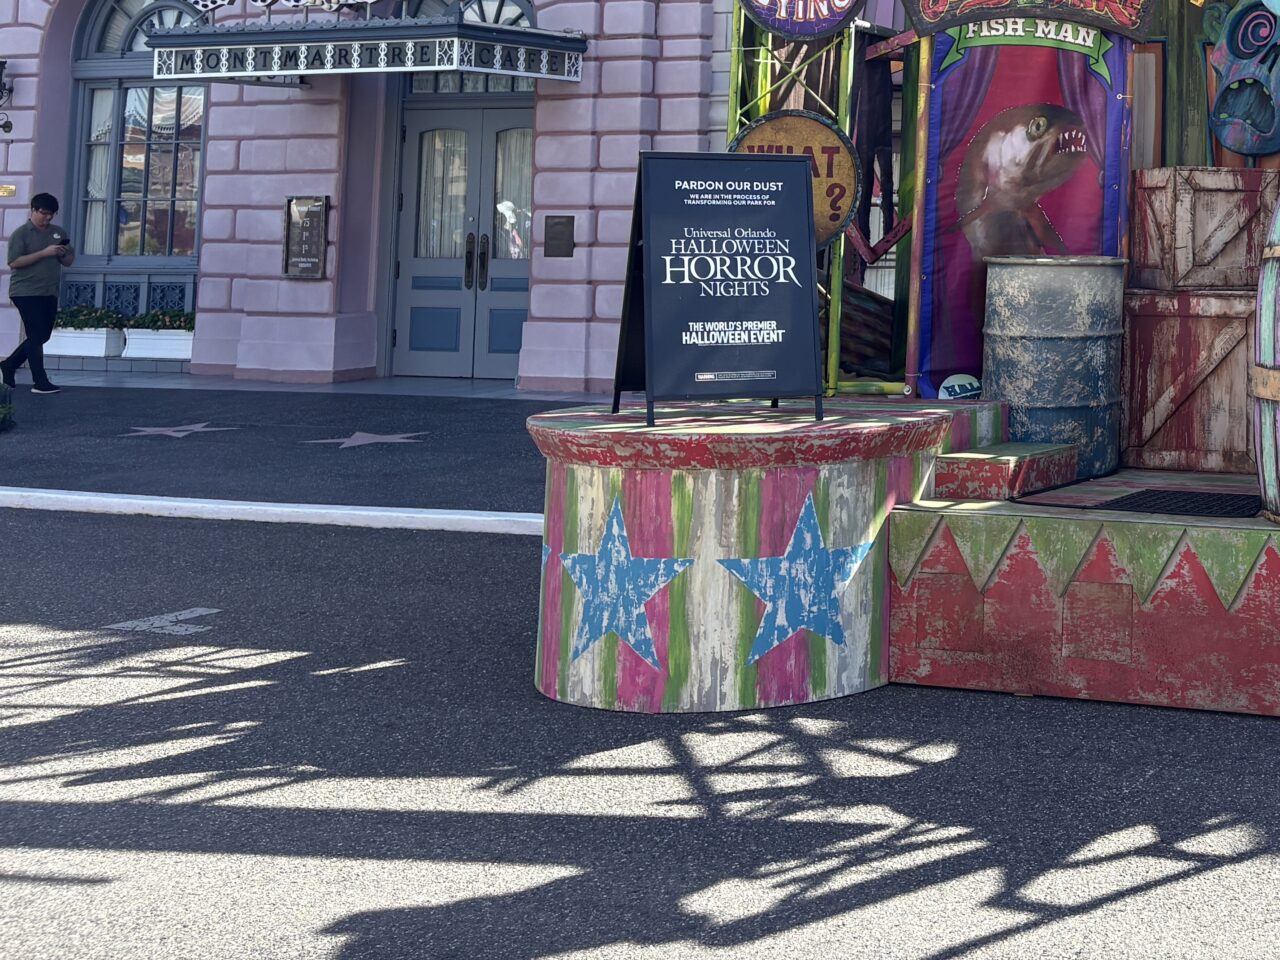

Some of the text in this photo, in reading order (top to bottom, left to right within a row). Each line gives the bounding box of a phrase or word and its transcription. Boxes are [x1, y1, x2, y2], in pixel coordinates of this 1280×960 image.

[965, 17, 1098, 47] FISH-MAN
[179, 45, 559, 73] MONTMARTRE CAFE
[675, 180, 783, 191] PARDON OUR DUST
[684, 227, 776, 238] Universal Orlando
[670, 239, 790, 254] HALLOWEEN
[661, 255, 802, 288] HORROR
[699, 280, 770, 297] NIGHTS
[688, 320, 777, 332] THE WORLD'S PREMIER
[682, 329, 786, 345] HALLOWEEN EVENT
